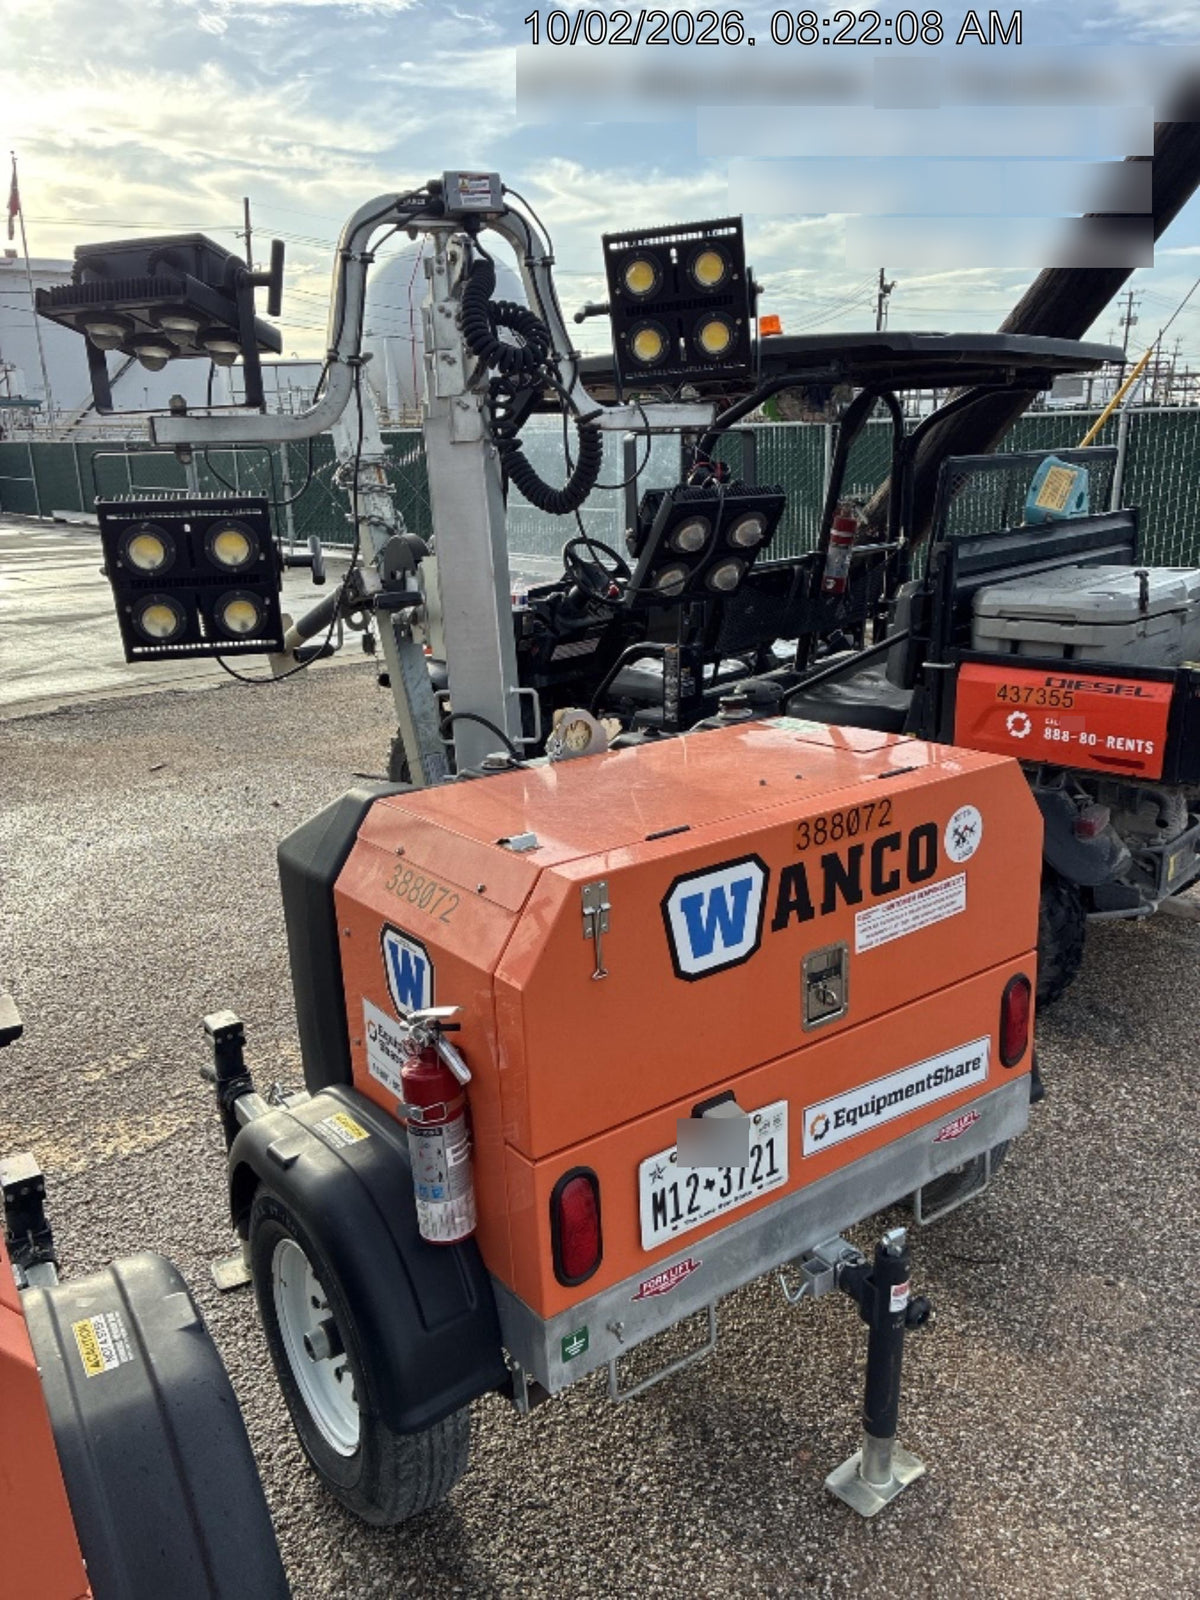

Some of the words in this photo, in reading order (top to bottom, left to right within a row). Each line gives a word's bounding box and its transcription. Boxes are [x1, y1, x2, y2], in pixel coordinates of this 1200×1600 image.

[997, 684, 1074, 708] 437355
[1045, 677, 1156, 698] DIESEL
[796, 799, 893, 850] 388072
[385, 864, 461, 923] 388072
[833, 1056, 982, 1130] EquipmentShare
[77, 1323, 99, 1363] CAUTION
